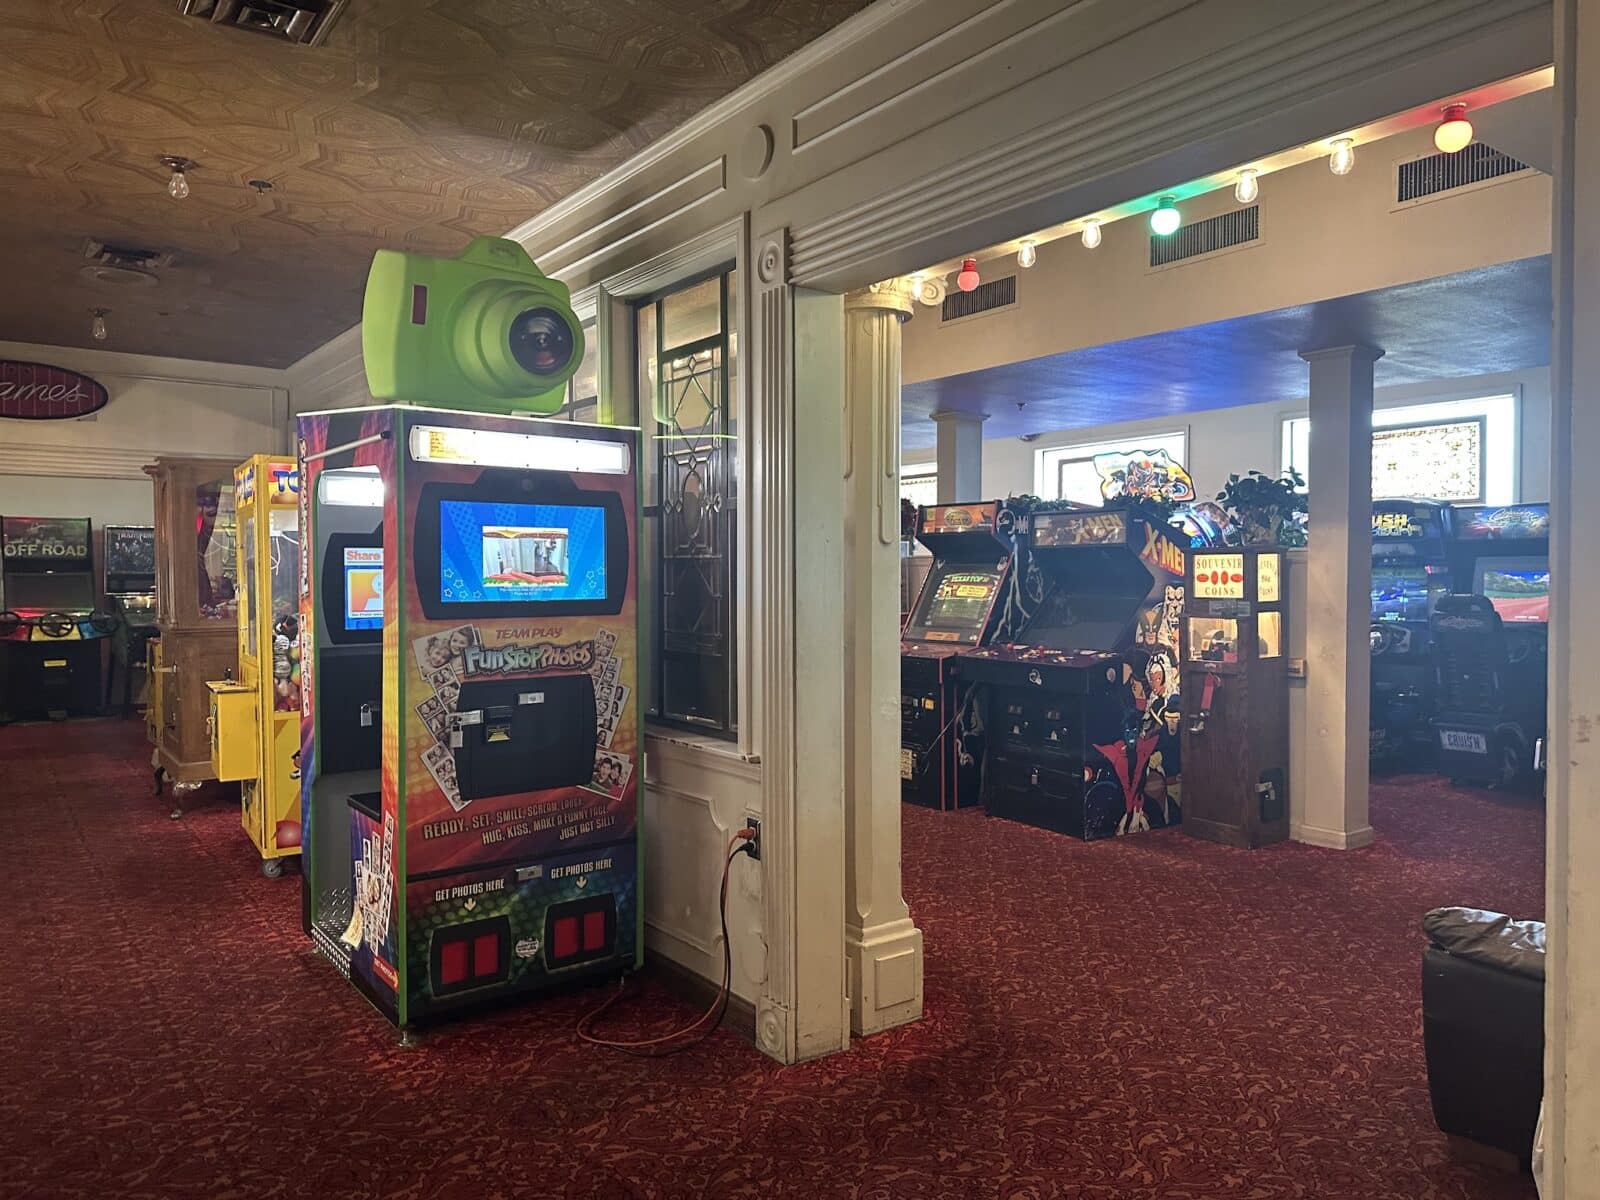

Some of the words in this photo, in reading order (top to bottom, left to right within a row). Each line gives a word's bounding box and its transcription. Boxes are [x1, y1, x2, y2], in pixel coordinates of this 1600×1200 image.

[4, 544, 38, 556] OFF
[41, 544, 88, 557] ROAD
[346, 550, 381, 561] Share
[1196, 558, 1242, 569] SOUVENIR
[1204, 587, 1235, 596] COINS
[495, 628, 530, 640] TEAM
[531, 627, 563, 638] PLAY
[533, 819, 556, 832] MAKE
[564, 809, 589, 824] FUNNY
[559, 826, 580, 841] JUST
[580, 822, 594, 834] ACT
[596, 815, 616, 830] SILLY
[551, 867, 564, 880] GET
[565, 861, 594, 877] PHOTOS
[595, 858, 612, 870] HERE
[435, 889, 450, 902] GET
[452, 883, 483, 899] PHOTOS
[485, 878, 505, 891] HERE
